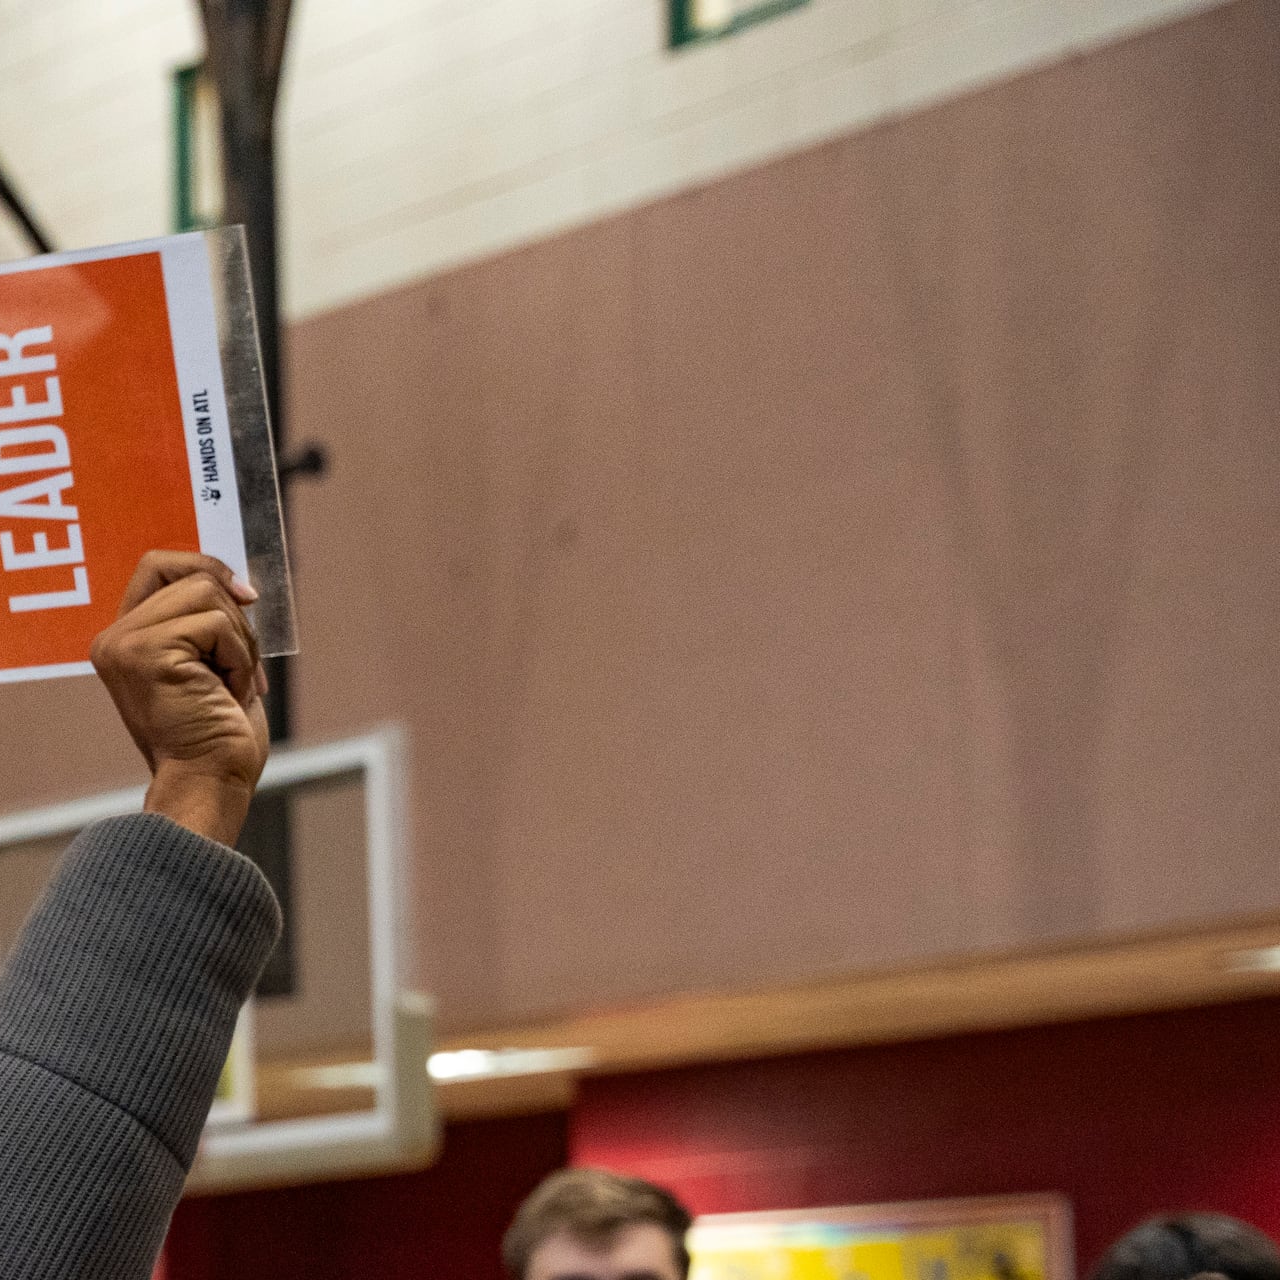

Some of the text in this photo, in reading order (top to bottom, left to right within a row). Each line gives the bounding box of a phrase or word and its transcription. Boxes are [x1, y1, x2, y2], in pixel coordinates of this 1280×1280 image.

[191, 387, 220, 483] HANDS ON ATL
